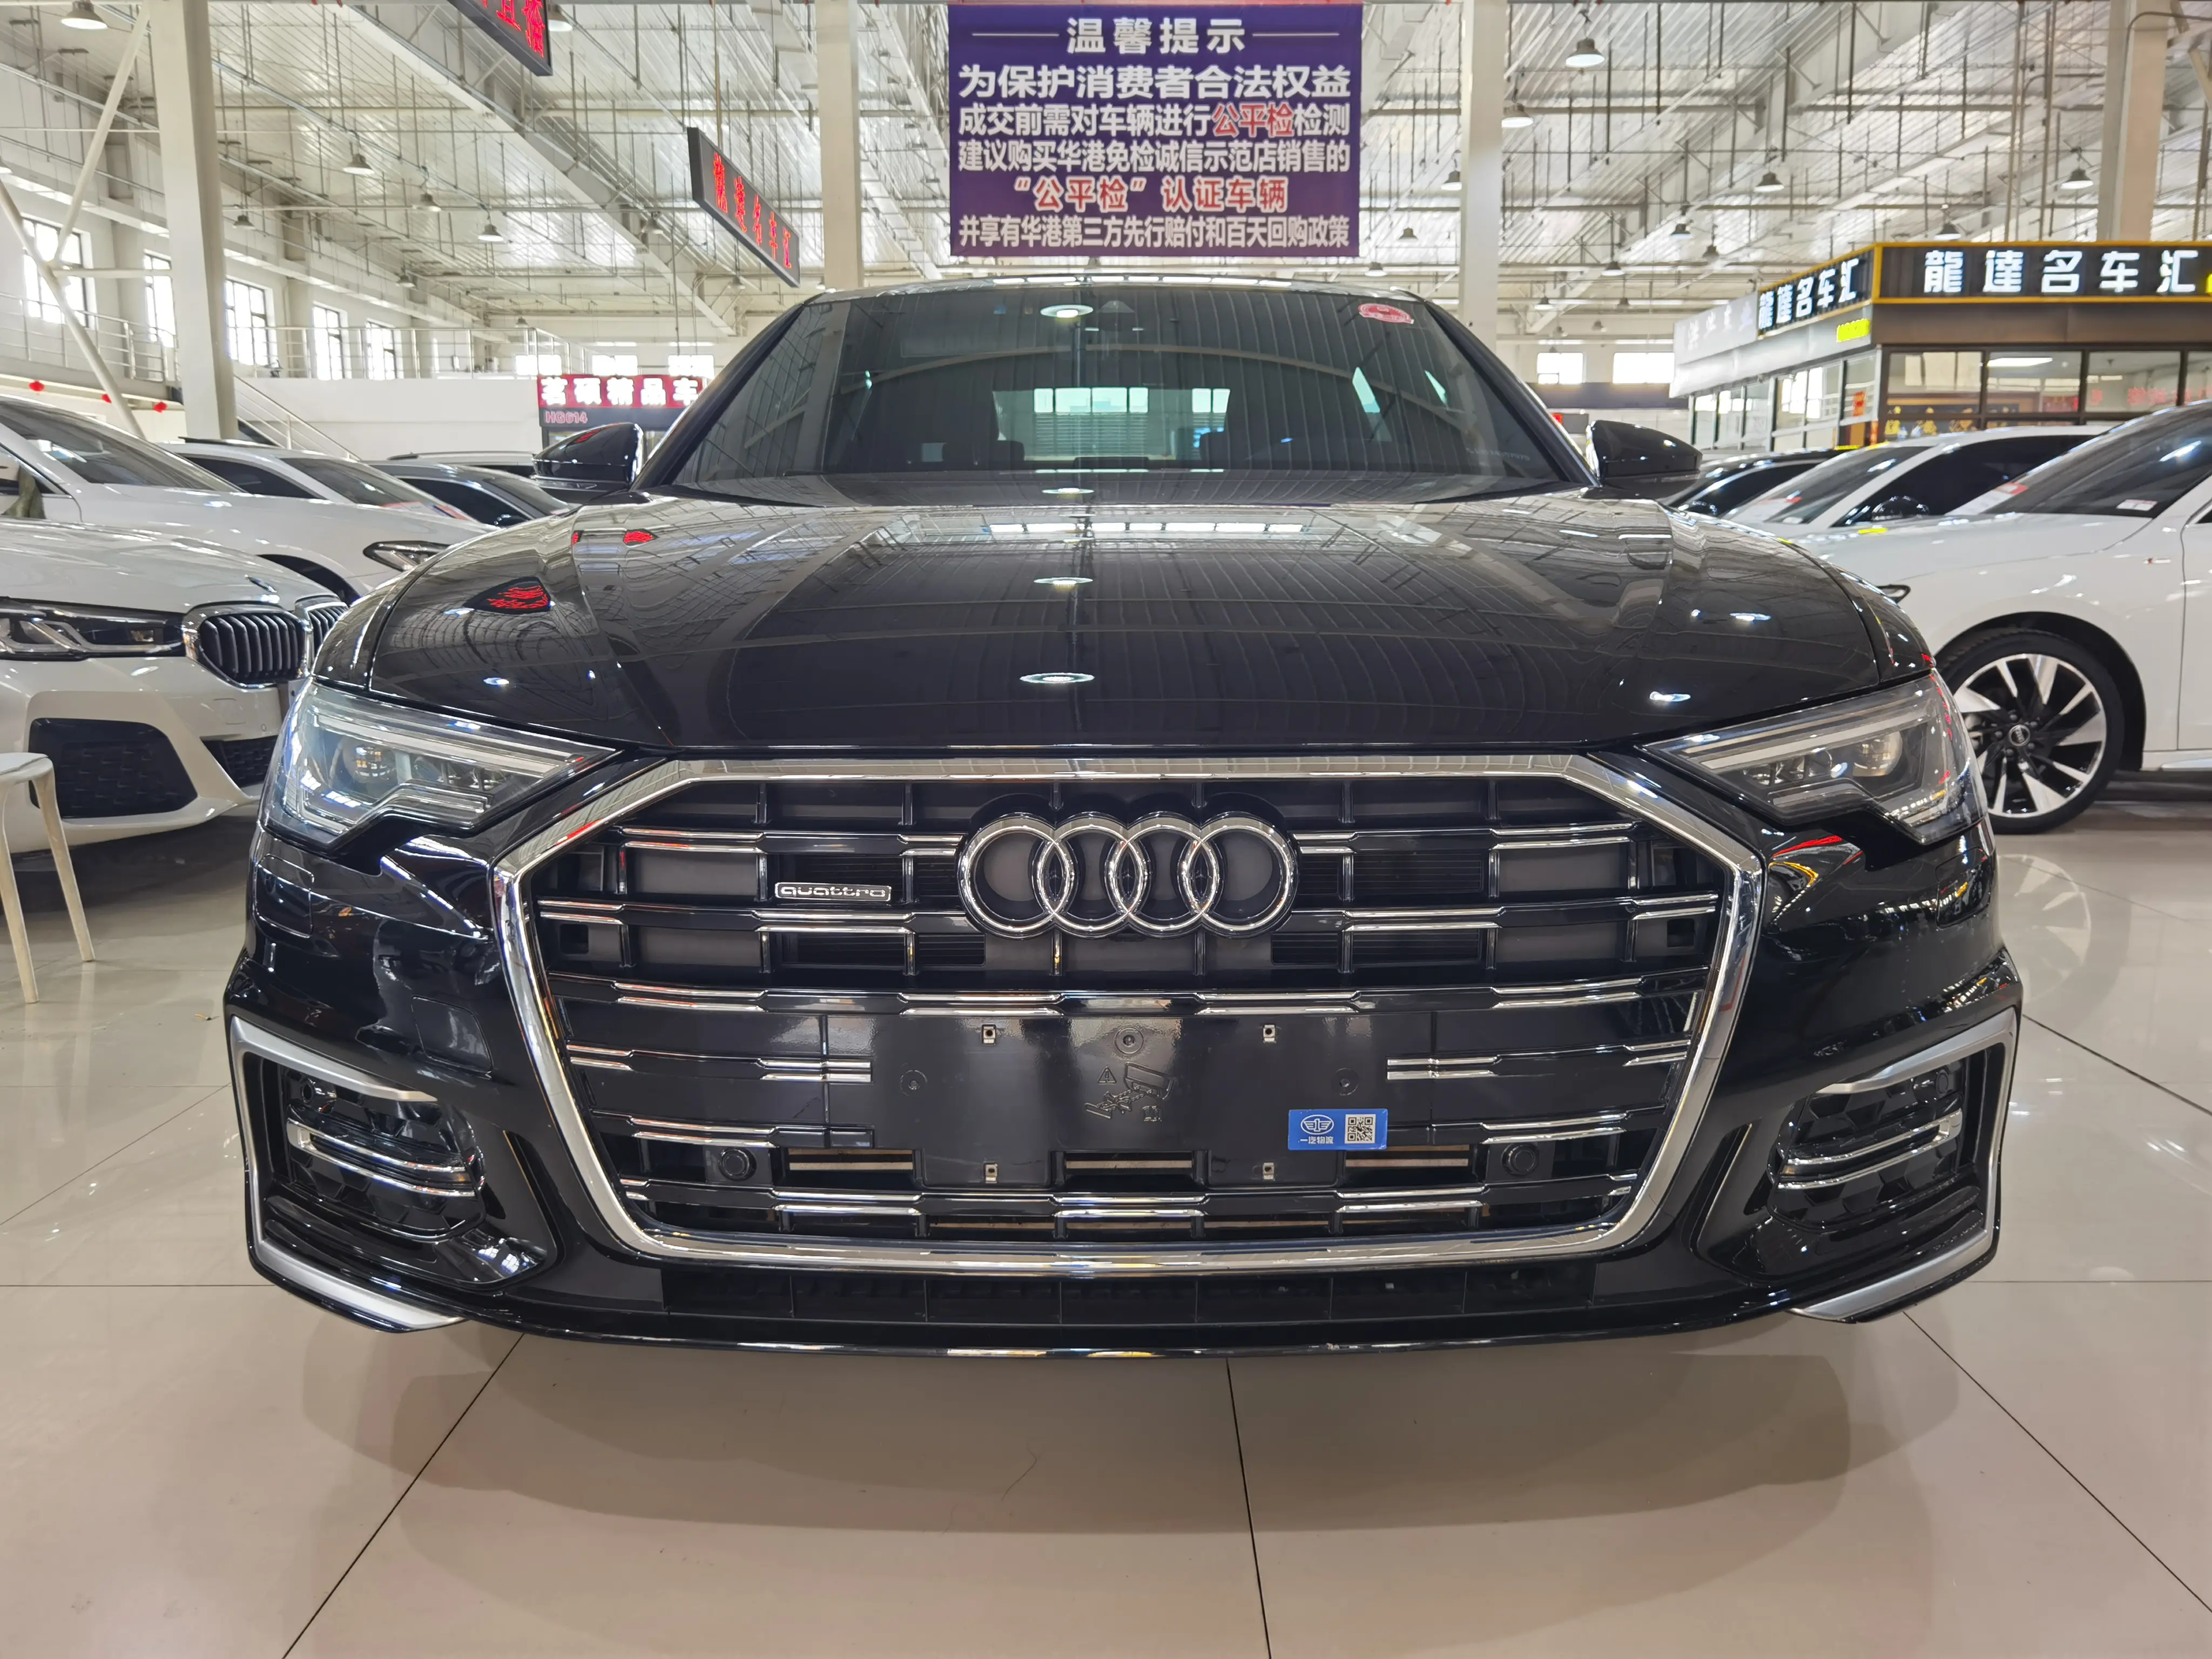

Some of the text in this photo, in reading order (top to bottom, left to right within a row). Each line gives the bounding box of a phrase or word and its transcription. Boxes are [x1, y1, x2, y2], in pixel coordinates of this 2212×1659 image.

[1067, 17, 1245, 53] 温馨提示
[959, 65, 1351, 99] 为保护消费者合法权益
[959, 103, 1350, 137] 成交前需对车辆进行公平检检测
[958, 140, 1351, 172] 建议购买华港免检诚信示范店销售的
[959, 214, 1350, 247] 并享有华港第三方先行赔付和百天回购政策
[1924, 249, 2198, 293] 龍達名车汇
[1758, 258, 1860, 330] 龍達名车汇
[545, 411, 588, 424] HG614
[781, 886, 886, 897] quattro
[1300, 1136, 1334, 1144] 一汽物流
